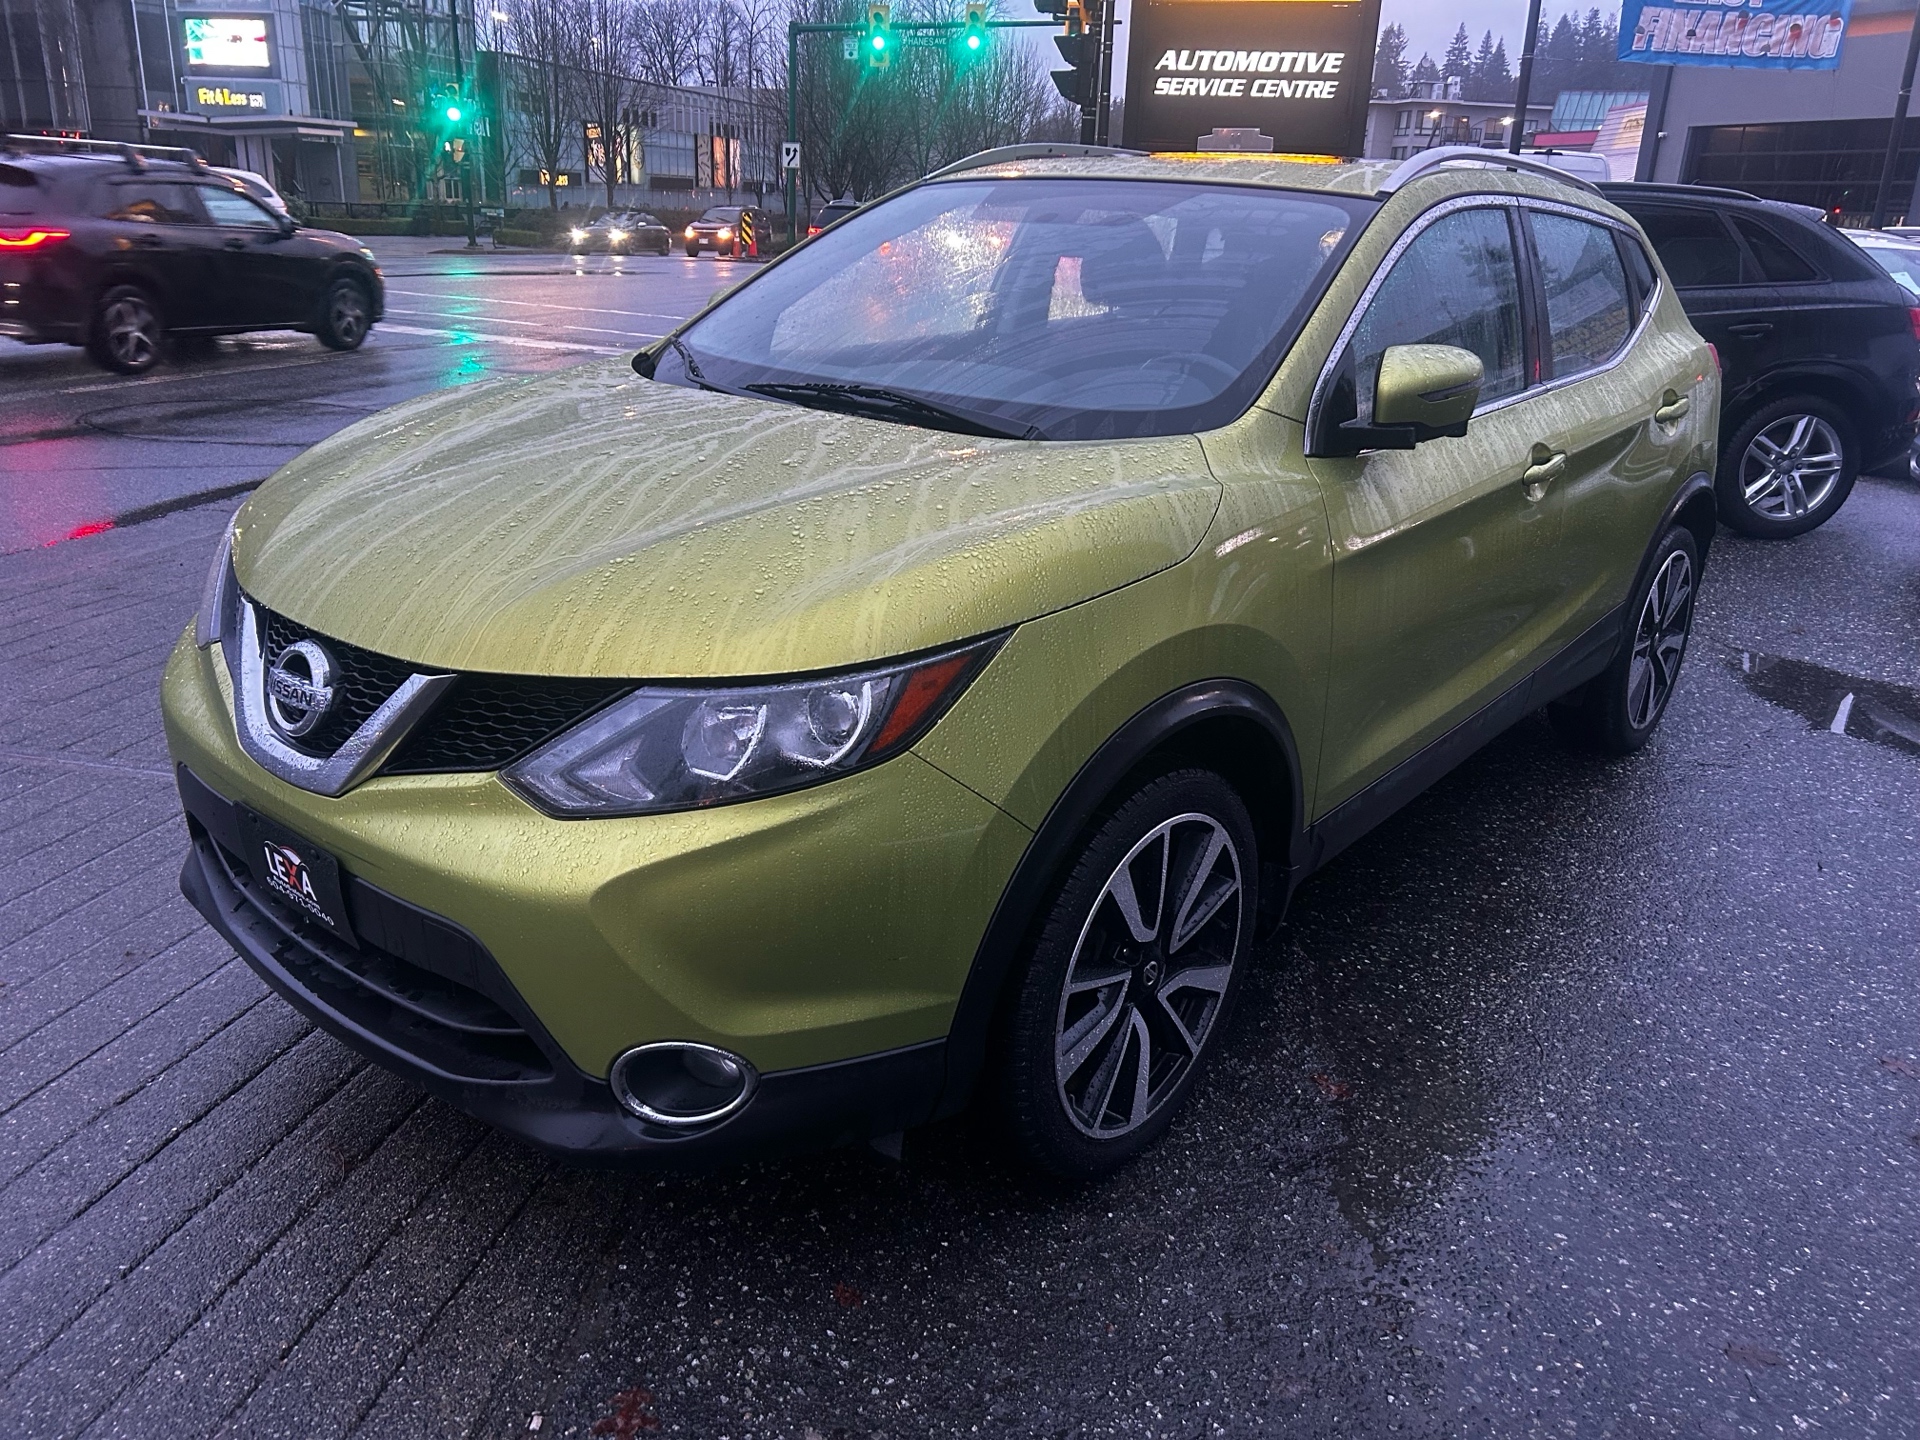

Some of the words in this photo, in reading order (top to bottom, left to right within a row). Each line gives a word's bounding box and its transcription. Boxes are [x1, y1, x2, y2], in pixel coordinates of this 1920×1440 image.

[1632, 6, 1844, 59] FINANCING
[1154, 50, 1345, 73] AUTOMOTIVE
[1153, 77, 1247, 97] SERVICE
[1250, 79, 1339, 99] CENTRE
[264, 846, 317, 901] LEXA
